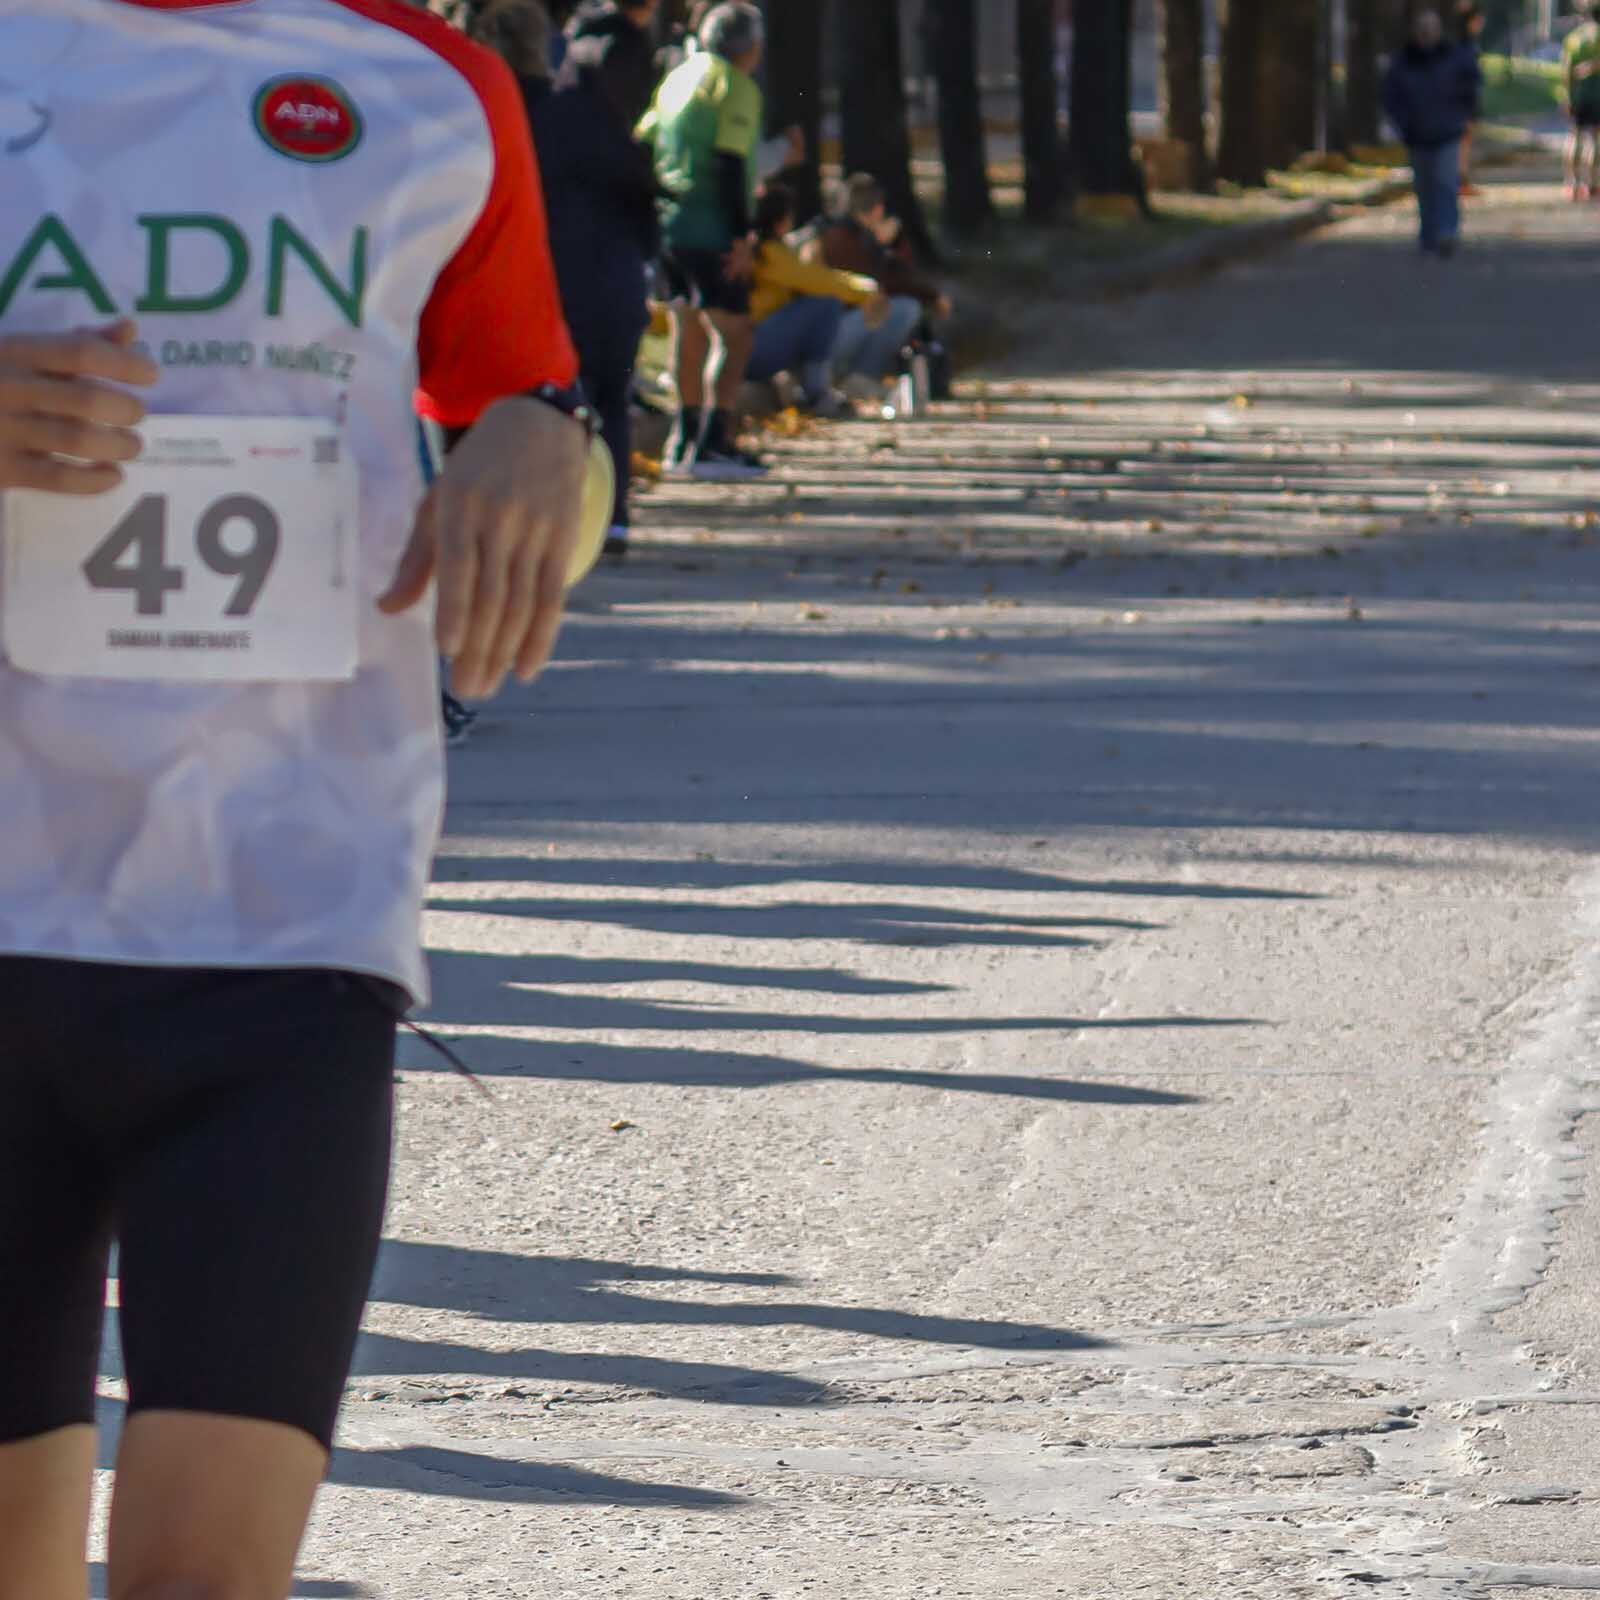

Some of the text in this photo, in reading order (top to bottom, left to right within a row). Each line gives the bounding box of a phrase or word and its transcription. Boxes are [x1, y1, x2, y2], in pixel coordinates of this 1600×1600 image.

[273, 100, 340, 126] ADN
[161, 340, 255, 366] DARIO
[82, 492, 281, 617] 49
